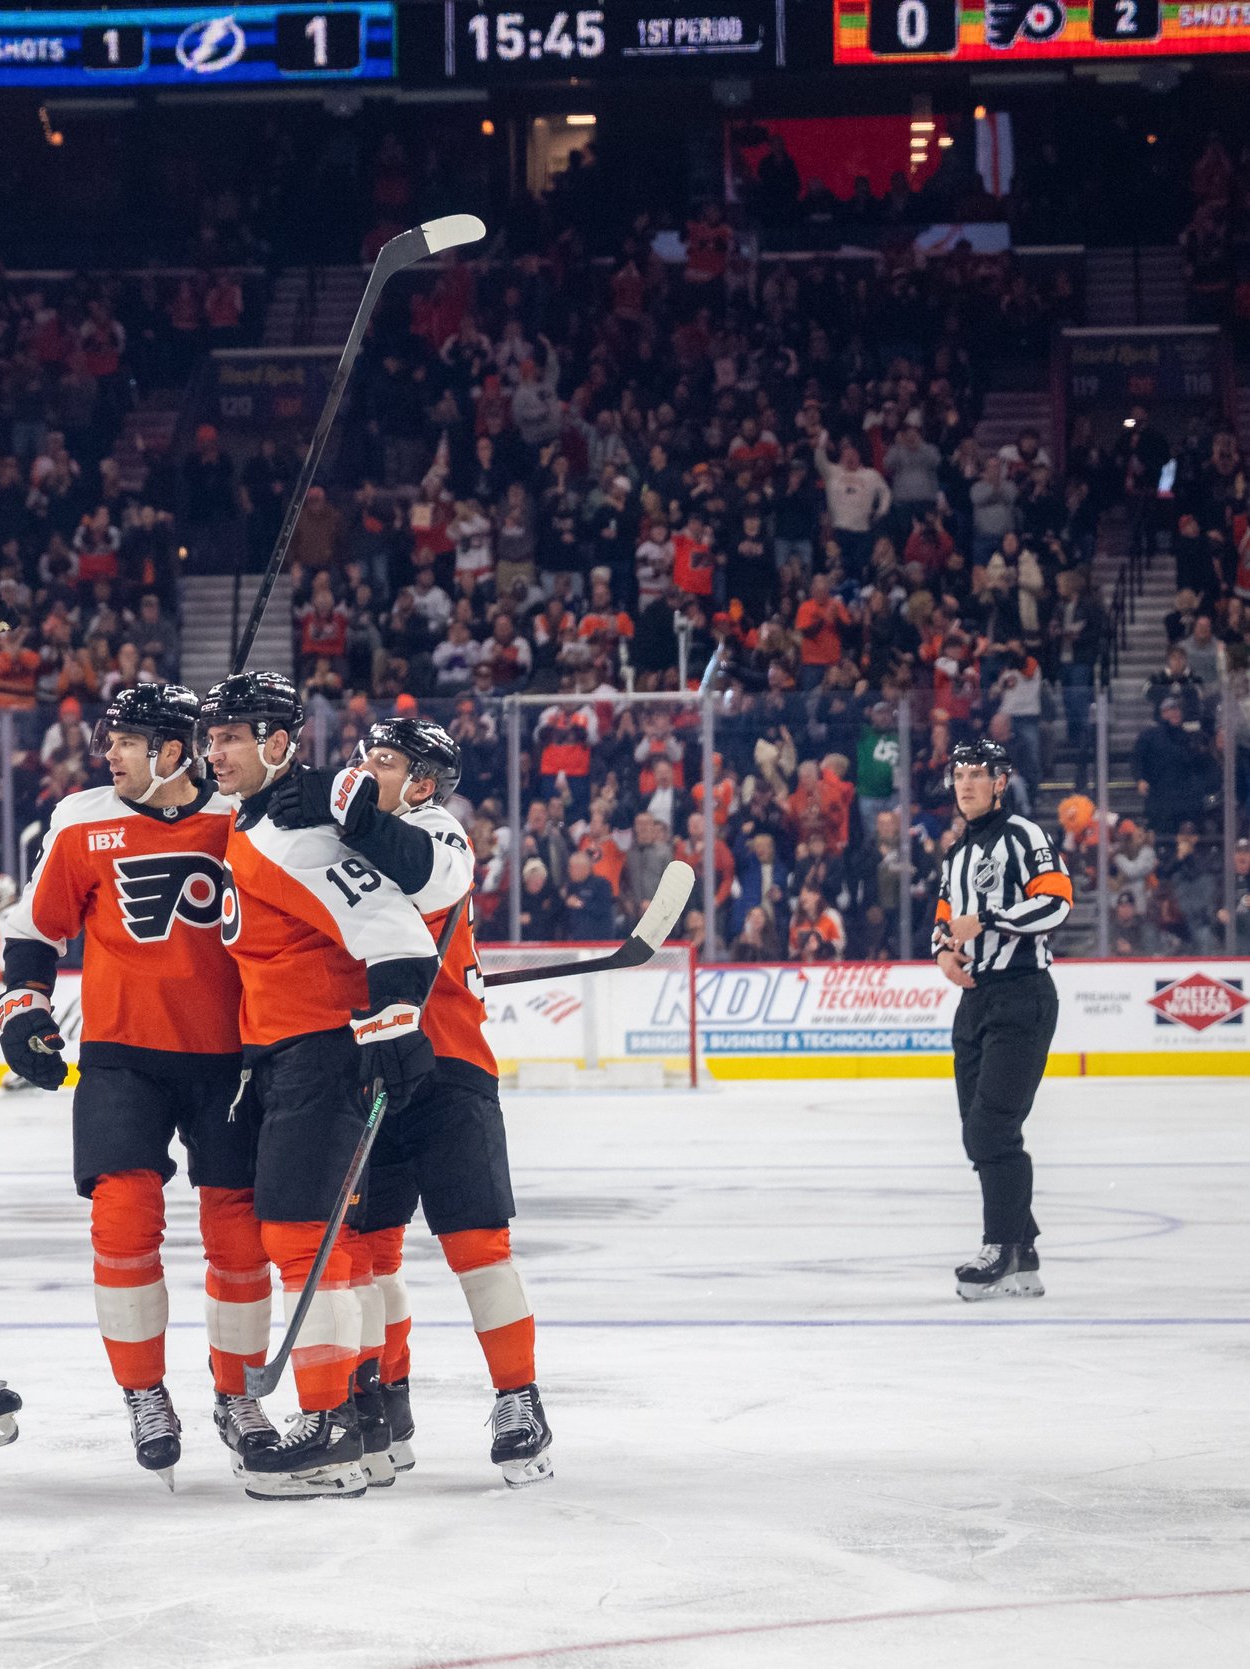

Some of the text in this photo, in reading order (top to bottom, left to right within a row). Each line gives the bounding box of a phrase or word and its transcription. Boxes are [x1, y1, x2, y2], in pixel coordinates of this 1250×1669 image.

[896, 0, 928, 48] 0
[1115, 0, 1137, 33] 2
[305, 16, 328, 66] 1
[468, 10, 605, 61] 15:45
[637, 16, 743, 46] 1ST PERIOD
[102, 29, 119, 63] 1
[88, 831, 126, 852] IBX
[1034, 848, 1053, 863] 45
[326, 857, 382, 909] 19
[822, 966, 892, 987] OFFICE
[816, 988, 947, 1010] TECHNOLOGY
[1075, 991, 1132, 1001] PREMIUM
[1172, 985, 1217, 1001] DIETZ
[1163, 1000, 1232, 1017] WATSON
[709, 1031, 783, 1050] BUSINESS
[786, 1031, 800, 1050] &
[802, 1031, 907, 1050] TECHNOLOGY
[911, 1031, 954, 1050] TOGE
